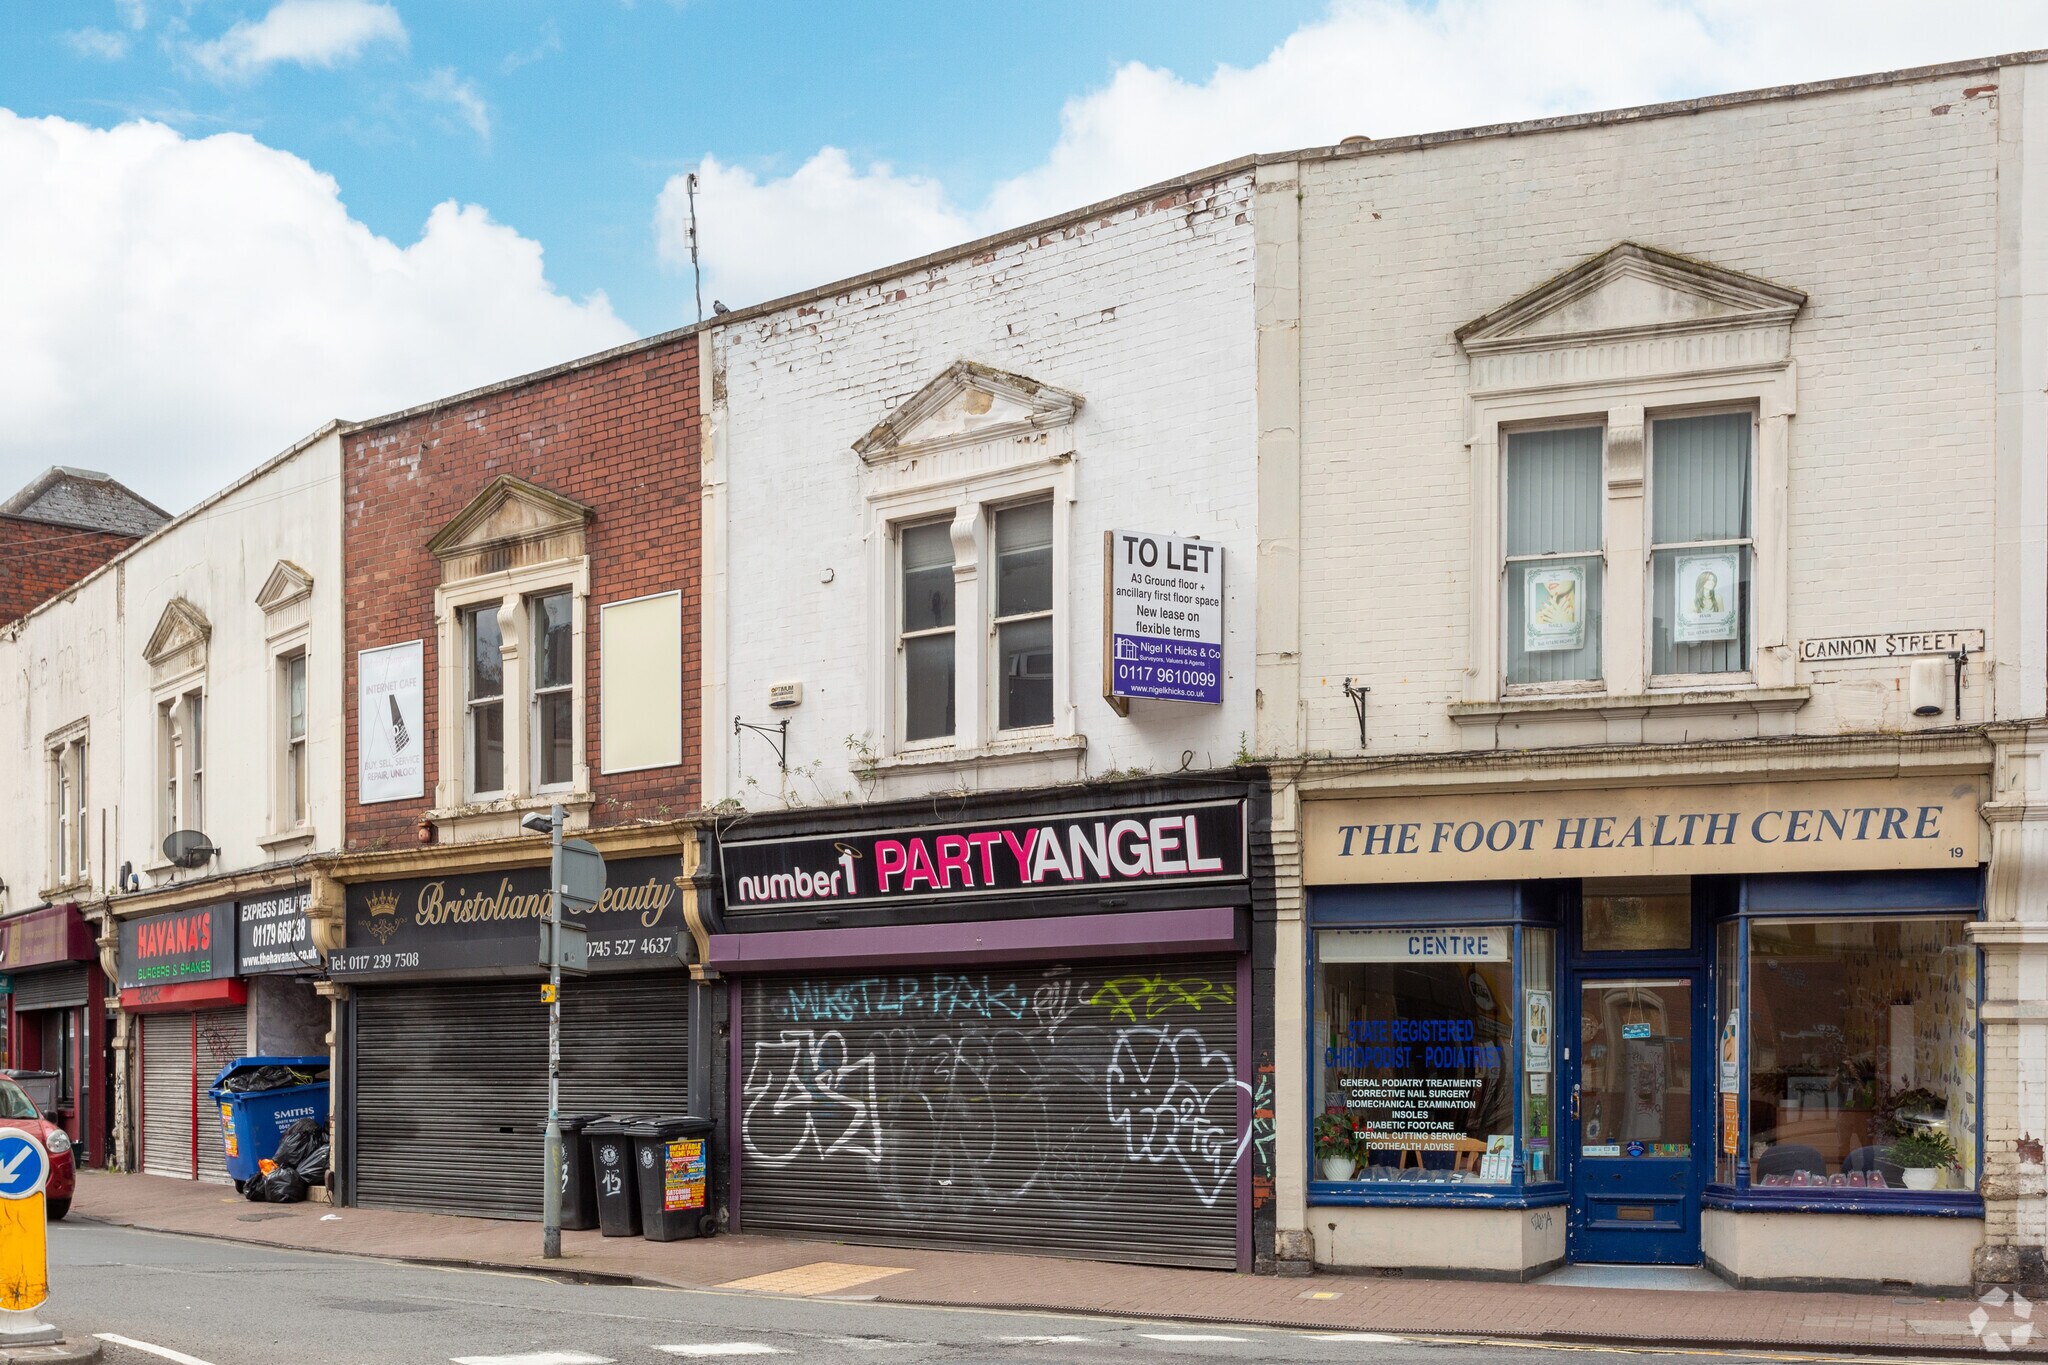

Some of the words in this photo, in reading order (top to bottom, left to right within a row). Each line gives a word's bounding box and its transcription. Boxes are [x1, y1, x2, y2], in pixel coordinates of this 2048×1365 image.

[1123, 536, 1158, 567] TO
[1167, 541, 1213, 573] LET
[1131, 573, 1142, 584] A3
[1145, 574, 1176, 588] Ground
[1178, 578, 1197, 590] floor
[1116, 587, 1151, 602] ancillary
[1154, 591, 1171, 601] first
[1173, 593, 1193, 604] floor
[1195, 597, 1219, 609] space
[1136, 604, 1157, 618] New
[1160, 607, 1185, 621] lease
[1187, 613, 1199, 622] on
[1136, 621, 1171, 635] flexible
[1173, 625, 1200, 638] terms
[1140, 642, 1163, 656] Nigel
[1165, 644, 1172, 654] K
[1174, 645, 1198, 657] Hicks
[1200, 647, 1206, 658] &
[1209, 648, 1220, 659] Co
[1805, 638, 1877, 659] CANNON
[1885, 633, 1958, 653] STREET
[1189, 659, 1205, 667] Agents
[1119, 664, 1152, 681] 0117
[1157, 668, 1216, 687] 9610099
[366, 681, 397, 695] INTERNET
[399, 677, 416, 689] CAFE
[1130, 684, 1205, 698] www.nigelkhicks.co.uk
[395, 754, 420, 766] SERVICE
[390, 767, 417, 778] UNLOCK
[1337, 822, 1421, 857] THE
[1428, 818, 1544, 853] FOOT
[1552, 811, 1738, 850] HEALTH
[1750, 805, 1943, 844] CENTRE
[1948, 847, 1963, 858] 19
[241, 899, 277, 921] EXPRESS
[568, 877, 675, 928] eauty
[137, 911, 211, 960] HAVANA'S
[253, 923, 277, 947] 01179
[614, 939, 636, 955] 527
[640, 937, 672, 954] 4637
[1408, 936, 1489, 955] CENTRE
[138, 964, 170, 980] BURGERS
[172, 964, 178, 976] &
[180, 960, 211, 975] SHAKES
[330, 956, 346, 971] Tel:
[349, 955, 369, 969] 0117
[373, 954, 391, 969] 239
[395, 952, 419, 967] 7508
[1349, 1020, 1387, 1042] STATE
[1391, 1019, 1474, 1042] REGISTERED
[1325, 1046, 1411, 1069] CHIROPODIST
[1425, 1046, 1502, 1069] PODIATRIST
[1340, 1079, 1380, 1087] GENERAL
[1382, 1079, 1423, 1087] PODIATRY
[1426, 1079, 1482, 1087] TREATMENTS
[1352, 1089, 1405, 1098] CORRECTIVE
[1407, 1089, 1427, 1098] NAIL
[1429, 1090, 1470, 1098] SURGERY
[274, 1106, 315, 1119] SMITHS
[1346, 1100, 1416, 1108] BIOMECHANICAL
[1418, 1100, 1476, 1108] EXAMINATION
[1392, 1111, 1428, 1119] INSOLES
[1366, 1121, 1406, 1129] DIABETIC
[1407, 1122, 1455, 1130] FOOTCARE
[1353, 1131, 1389, 1139] TOENAIL
[1391, 1131, 1429, 1140] CUTTING
[1430, 1132, 1467, 1140] SERVICE
[1366, 1142, 1421, 1150] FOOTHEALTH
[602, 1169, 621, 1192] 15
